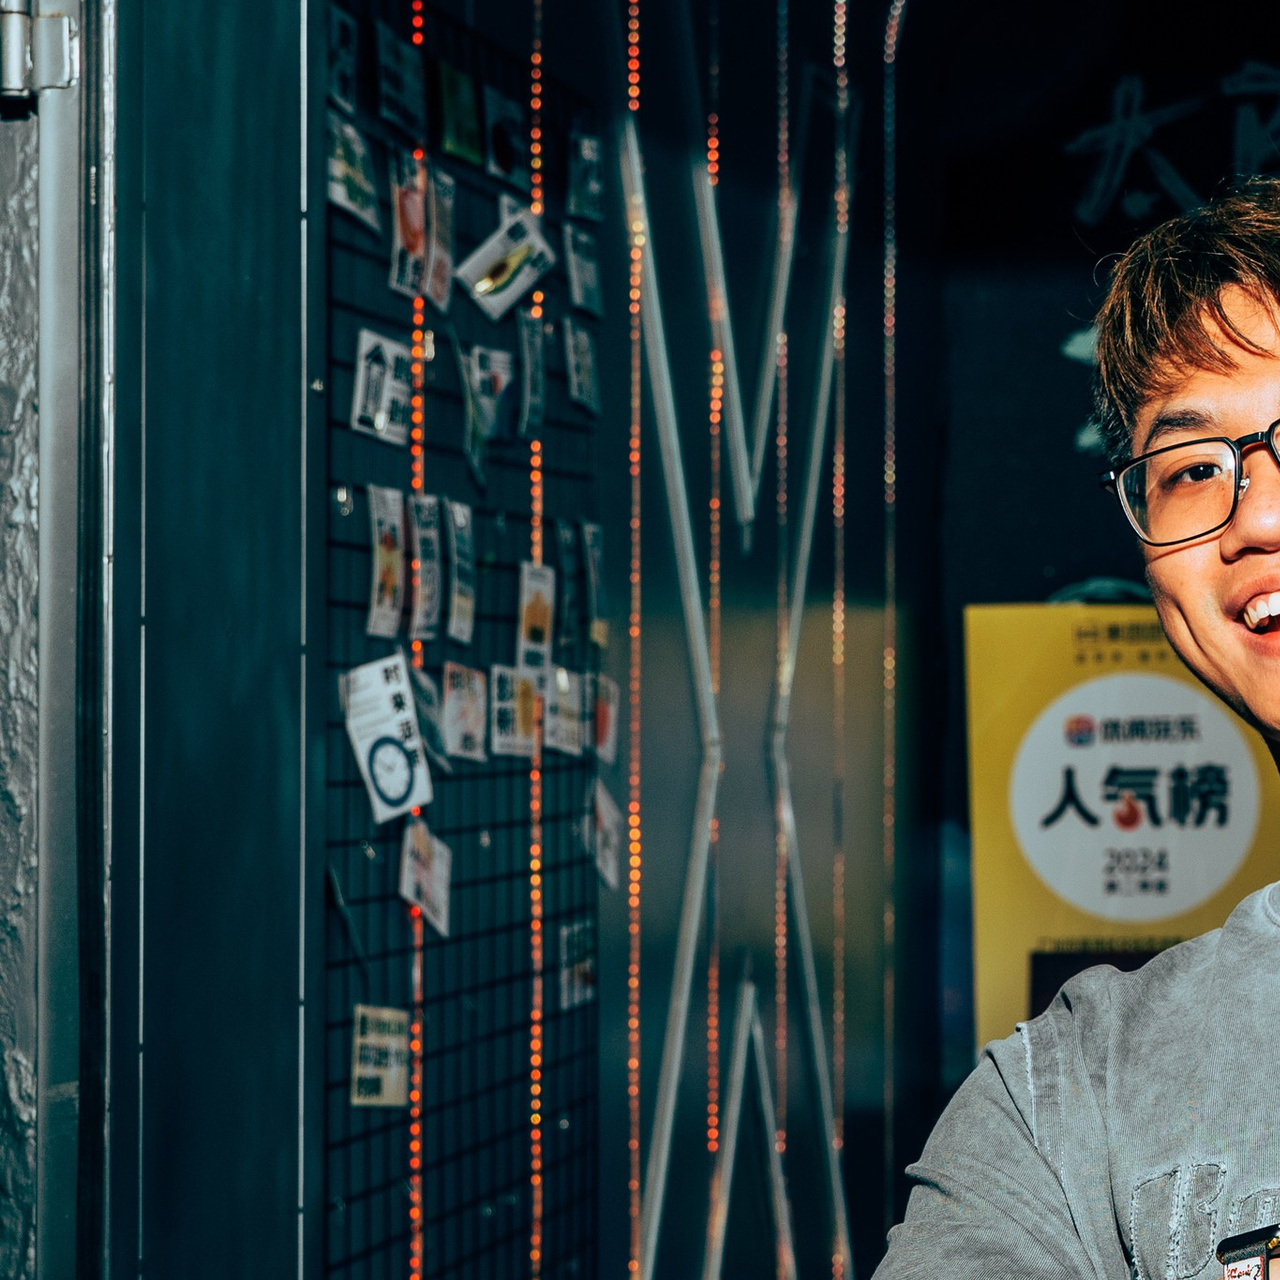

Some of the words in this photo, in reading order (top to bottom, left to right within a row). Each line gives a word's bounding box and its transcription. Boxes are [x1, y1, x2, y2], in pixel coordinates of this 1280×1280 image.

[1040, 763, 1231, 830] 人气榜
[1103, 847, 1169, 873] 2024
